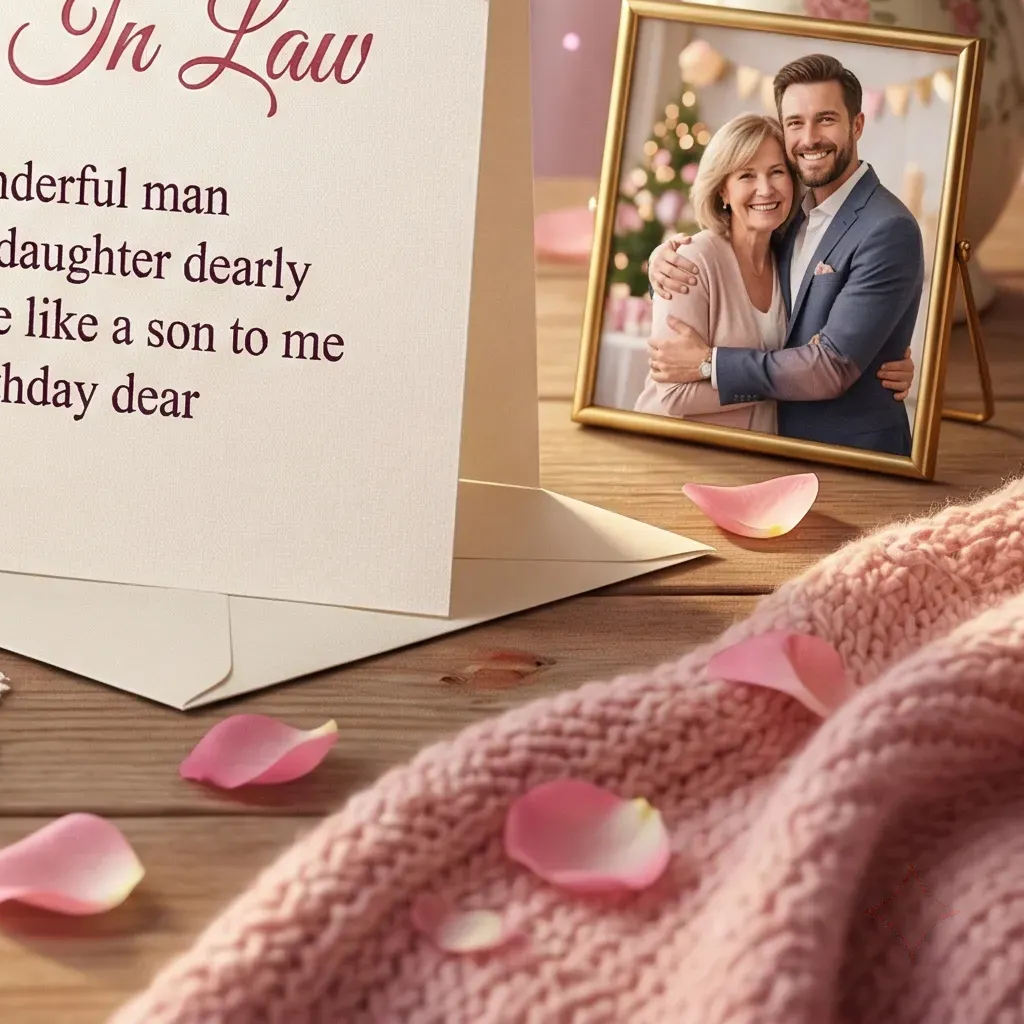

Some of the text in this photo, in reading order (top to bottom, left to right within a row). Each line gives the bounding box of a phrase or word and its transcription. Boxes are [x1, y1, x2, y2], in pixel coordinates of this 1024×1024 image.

[141, 181, 230, 217] man
[183, 240, 313, 303] dearly
[24, 295, 99, 343] like
[111, 316, 134, 346] a
[146, 318, 217, 353] son
[229, 318, 269, 357] to
[281, 330, 345, 363] me
[111, 371, 201, 420] dear
